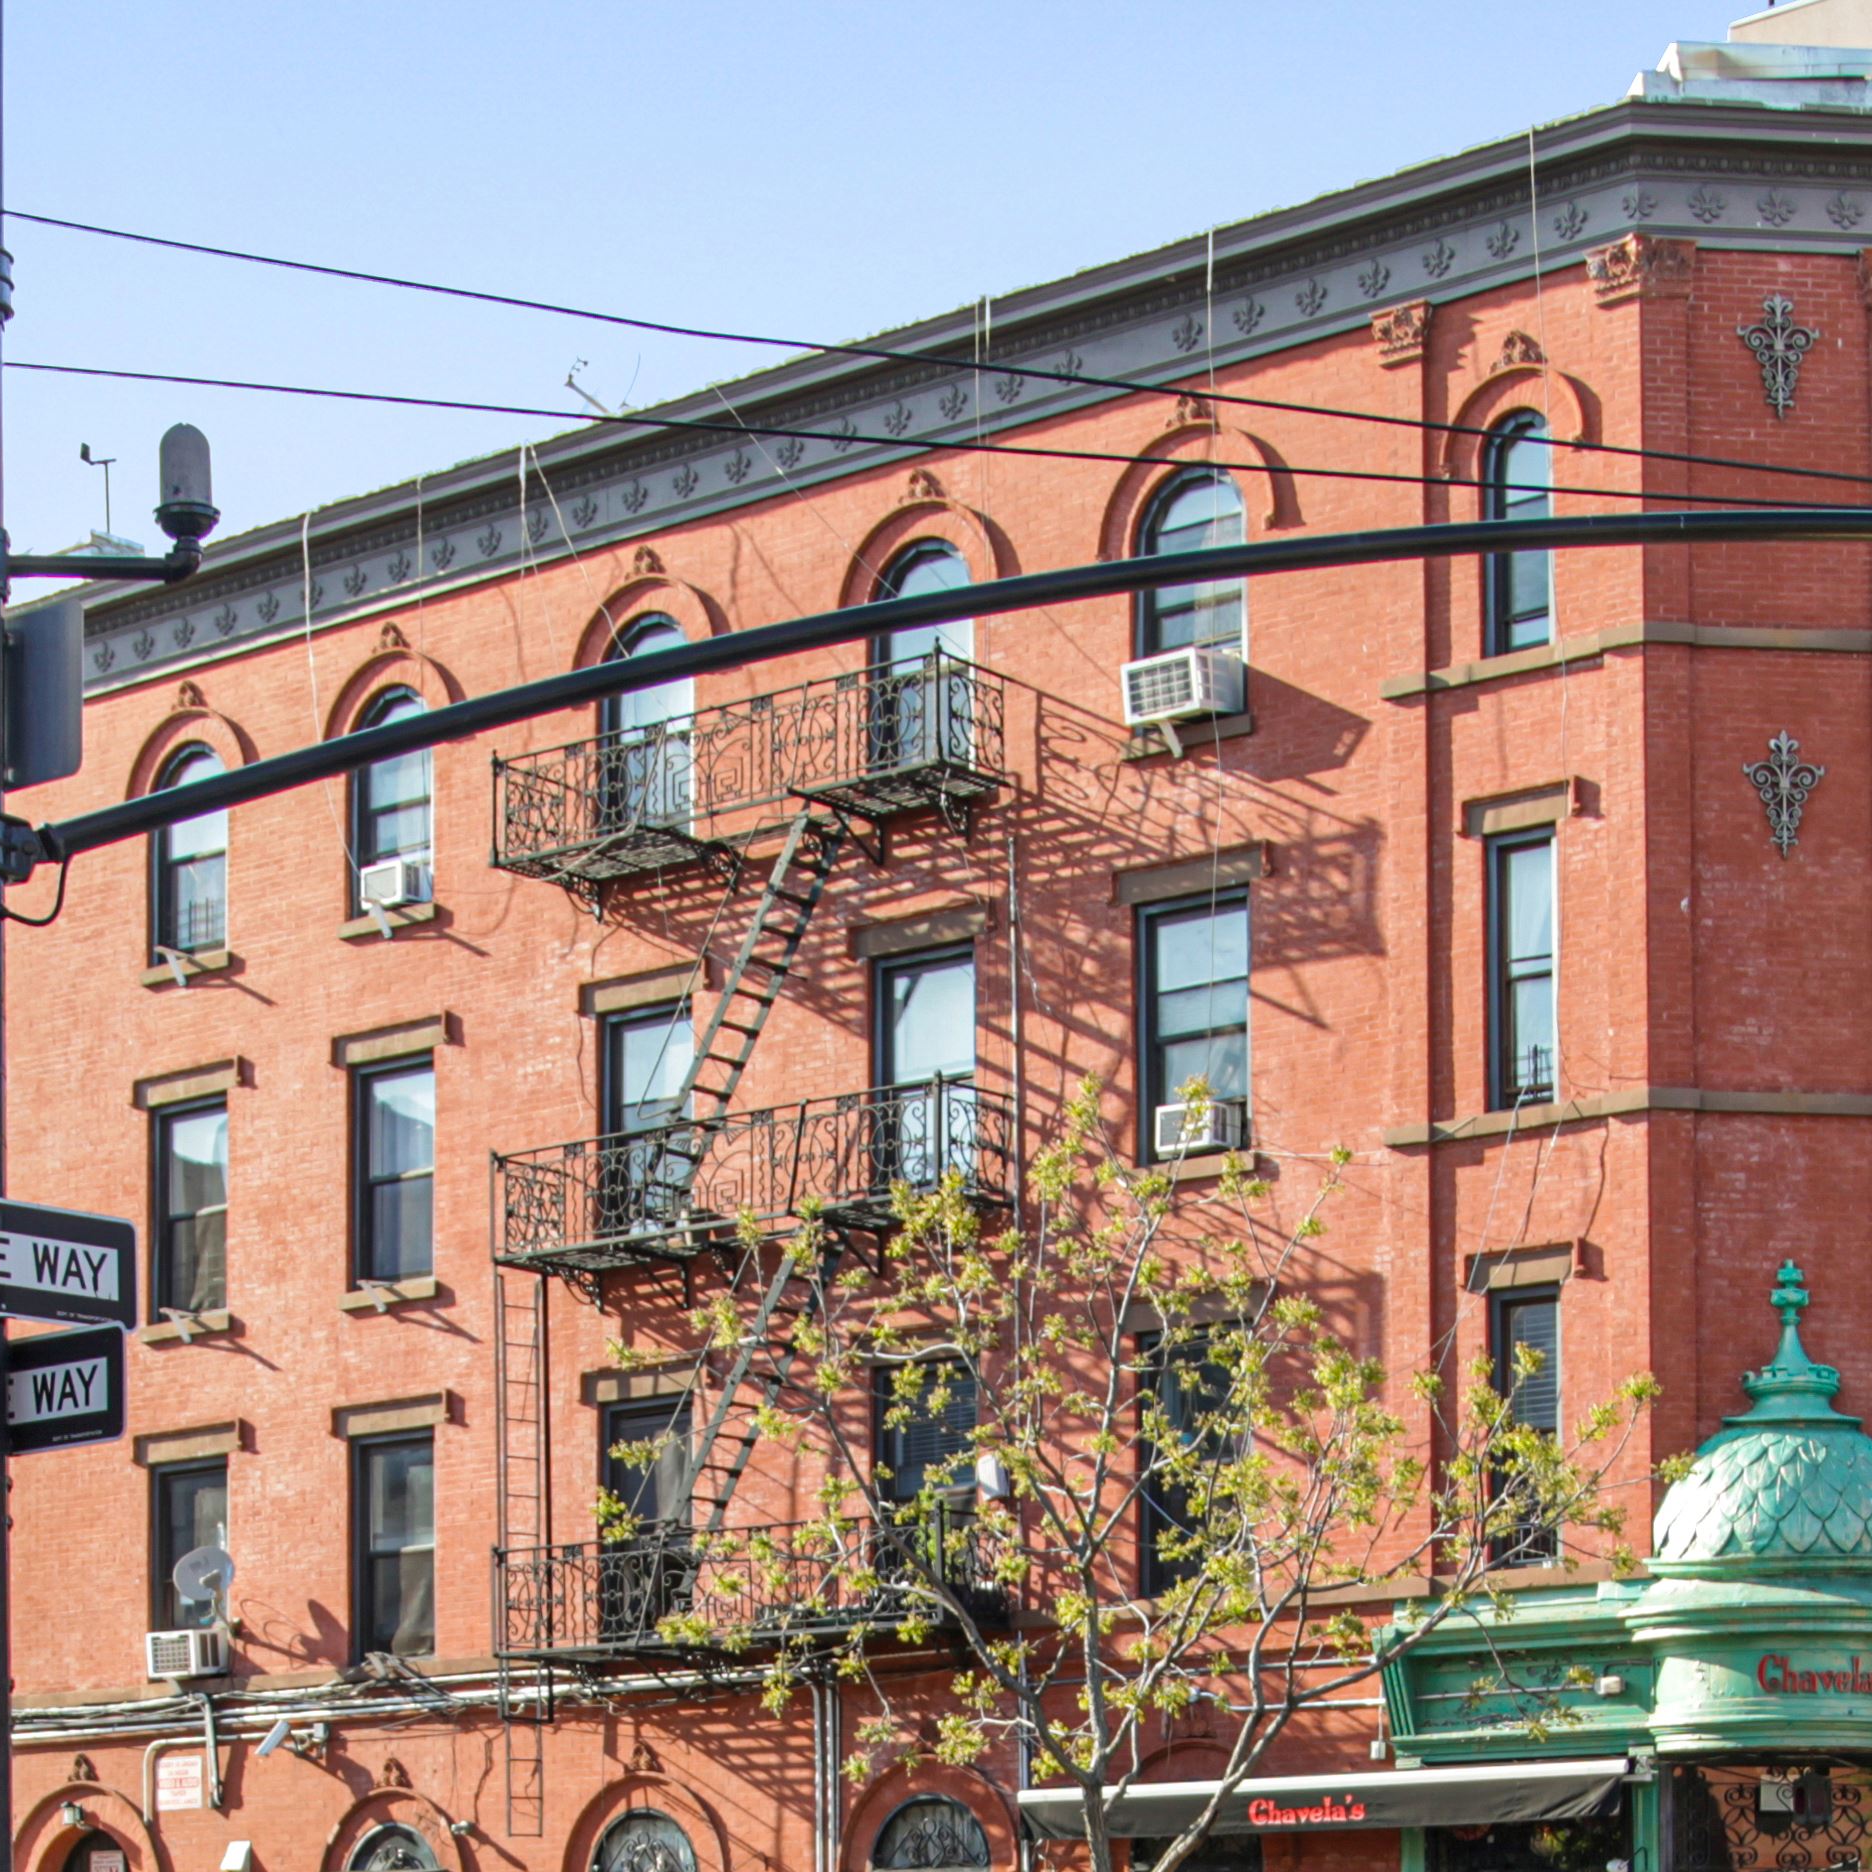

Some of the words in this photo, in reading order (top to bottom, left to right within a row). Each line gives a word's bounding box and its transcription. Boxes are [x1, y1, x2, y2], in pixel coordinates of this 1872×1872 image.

[32, 1242, 108, 1293] WAY
[32, 1364, 99, 1415] WAY
[1248, 1793, 1366, 1826] Chavela's
